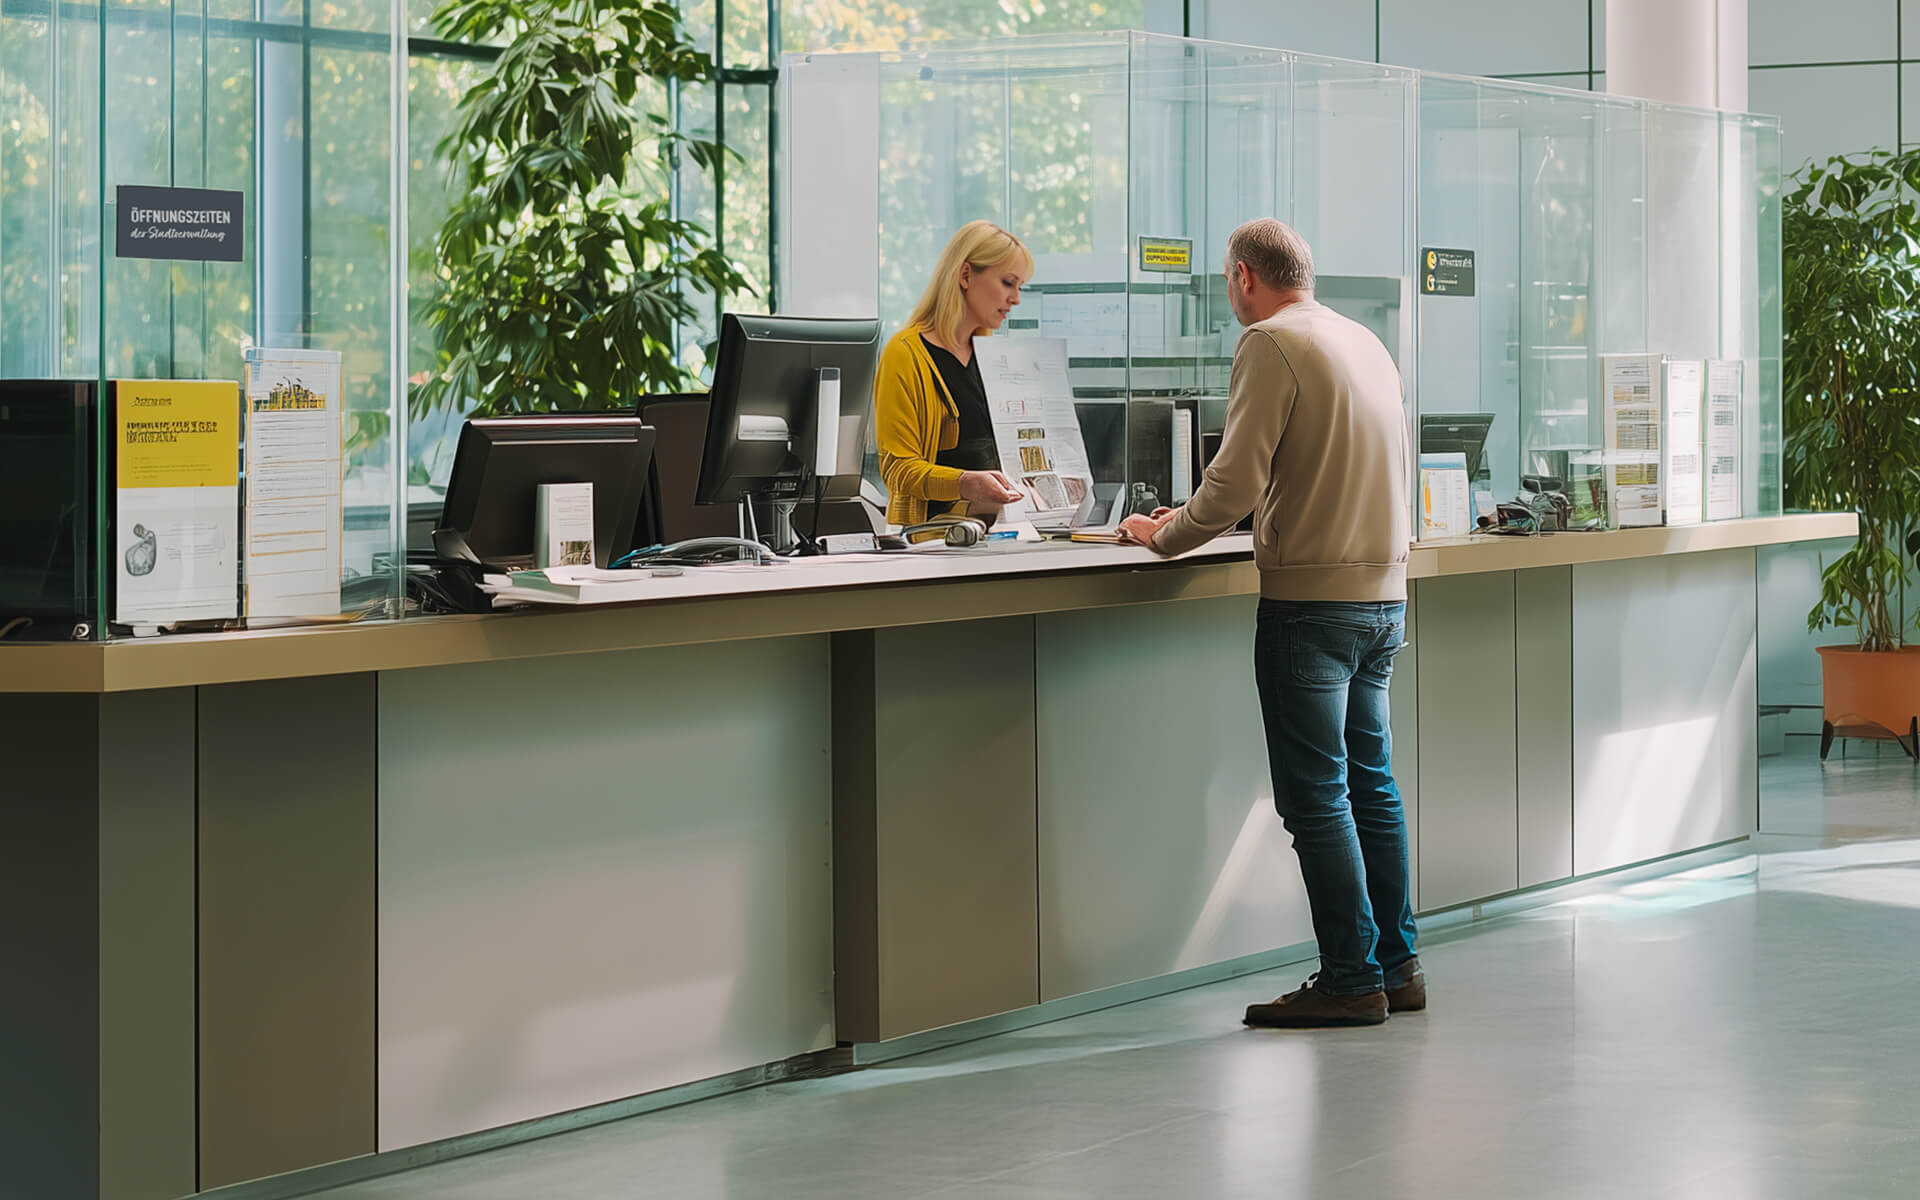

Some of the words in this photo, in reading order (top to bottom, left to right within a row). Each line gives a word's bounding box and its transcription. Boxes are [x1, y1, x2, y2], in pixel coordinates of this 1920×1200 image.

[130, 207, 231, 224] ÖFFNUNGSZEITEN
[130, 227, 147, 239] der
[148, 226, 226, 242] Stadtverwaltung
